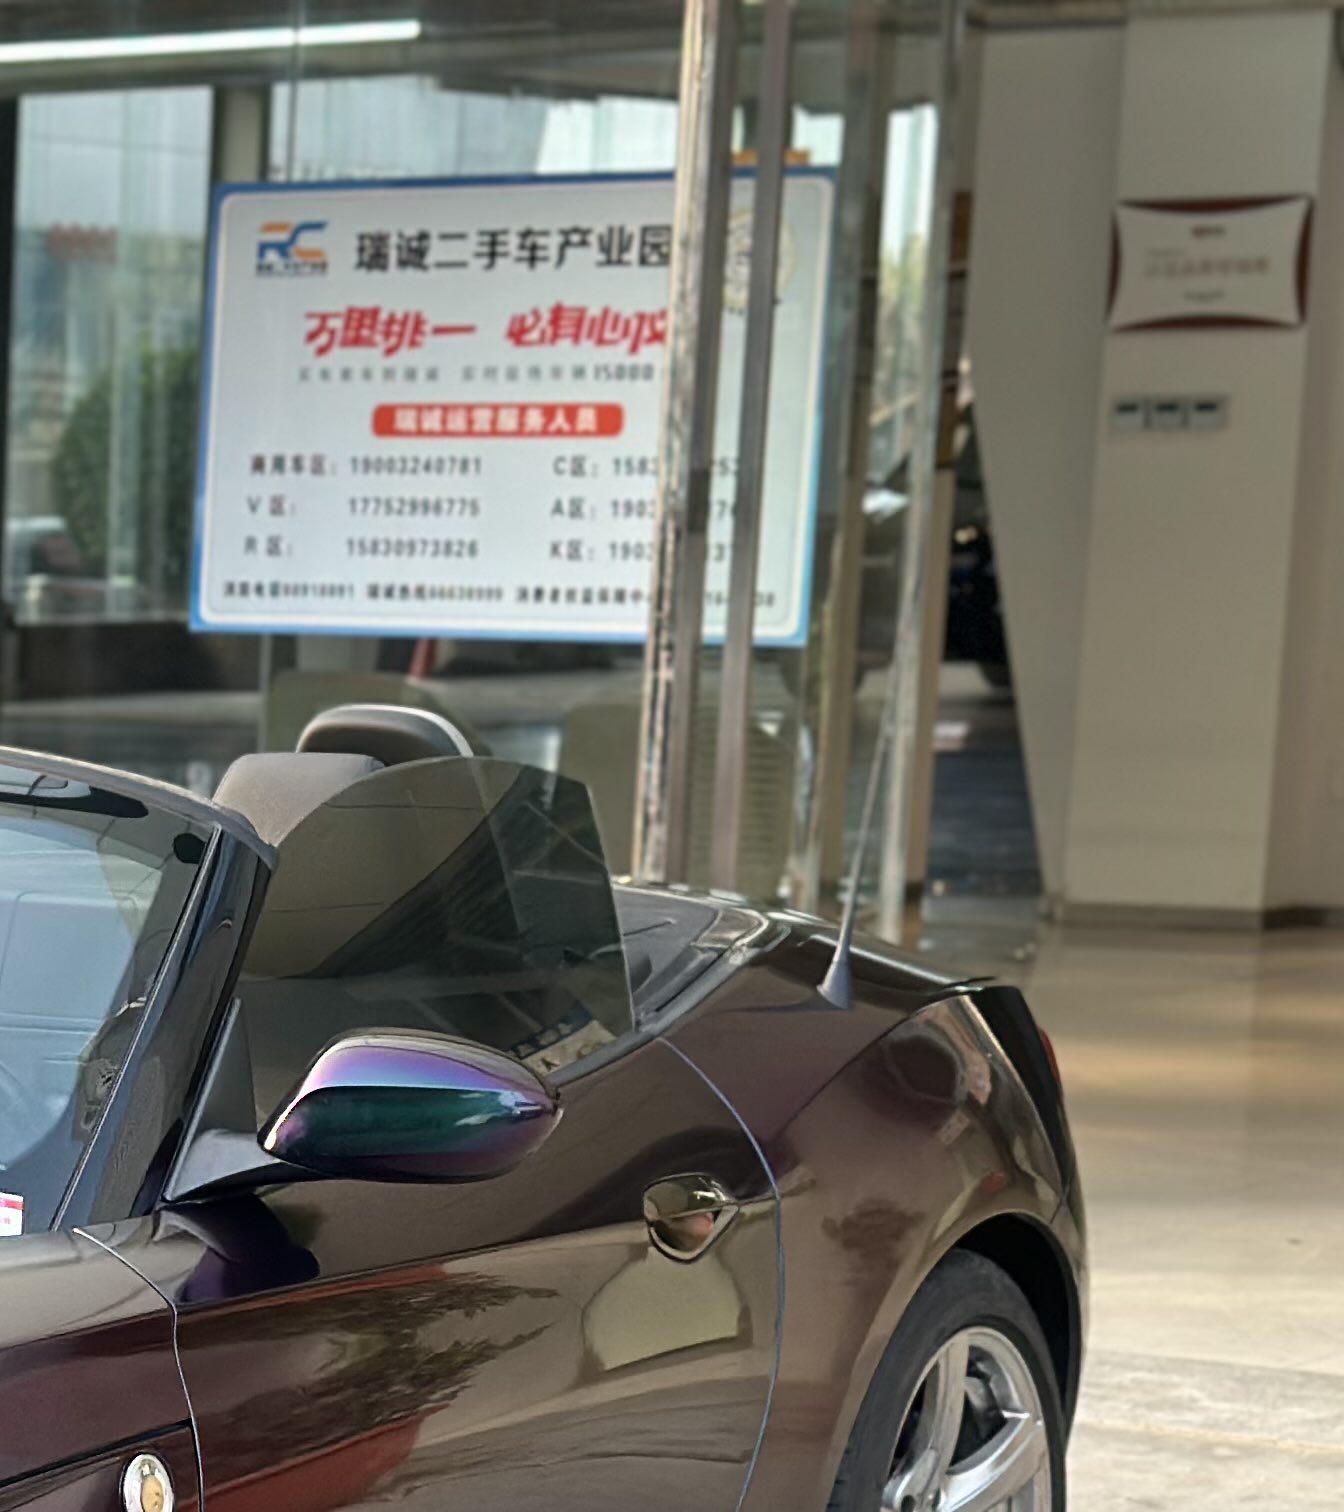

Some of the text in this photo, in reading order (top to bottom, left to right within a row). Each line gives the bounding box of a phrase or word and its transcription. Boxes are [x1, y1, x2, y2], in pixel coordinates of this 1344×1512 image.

[354, 225, 673, 272] 瑞诚二手车产业园
[305, 305, 478, 357] 万里挑一
[394, 406, 598, 434] 瑞诚运营服务人员
[350, 456, 483, 476] 19003240781
